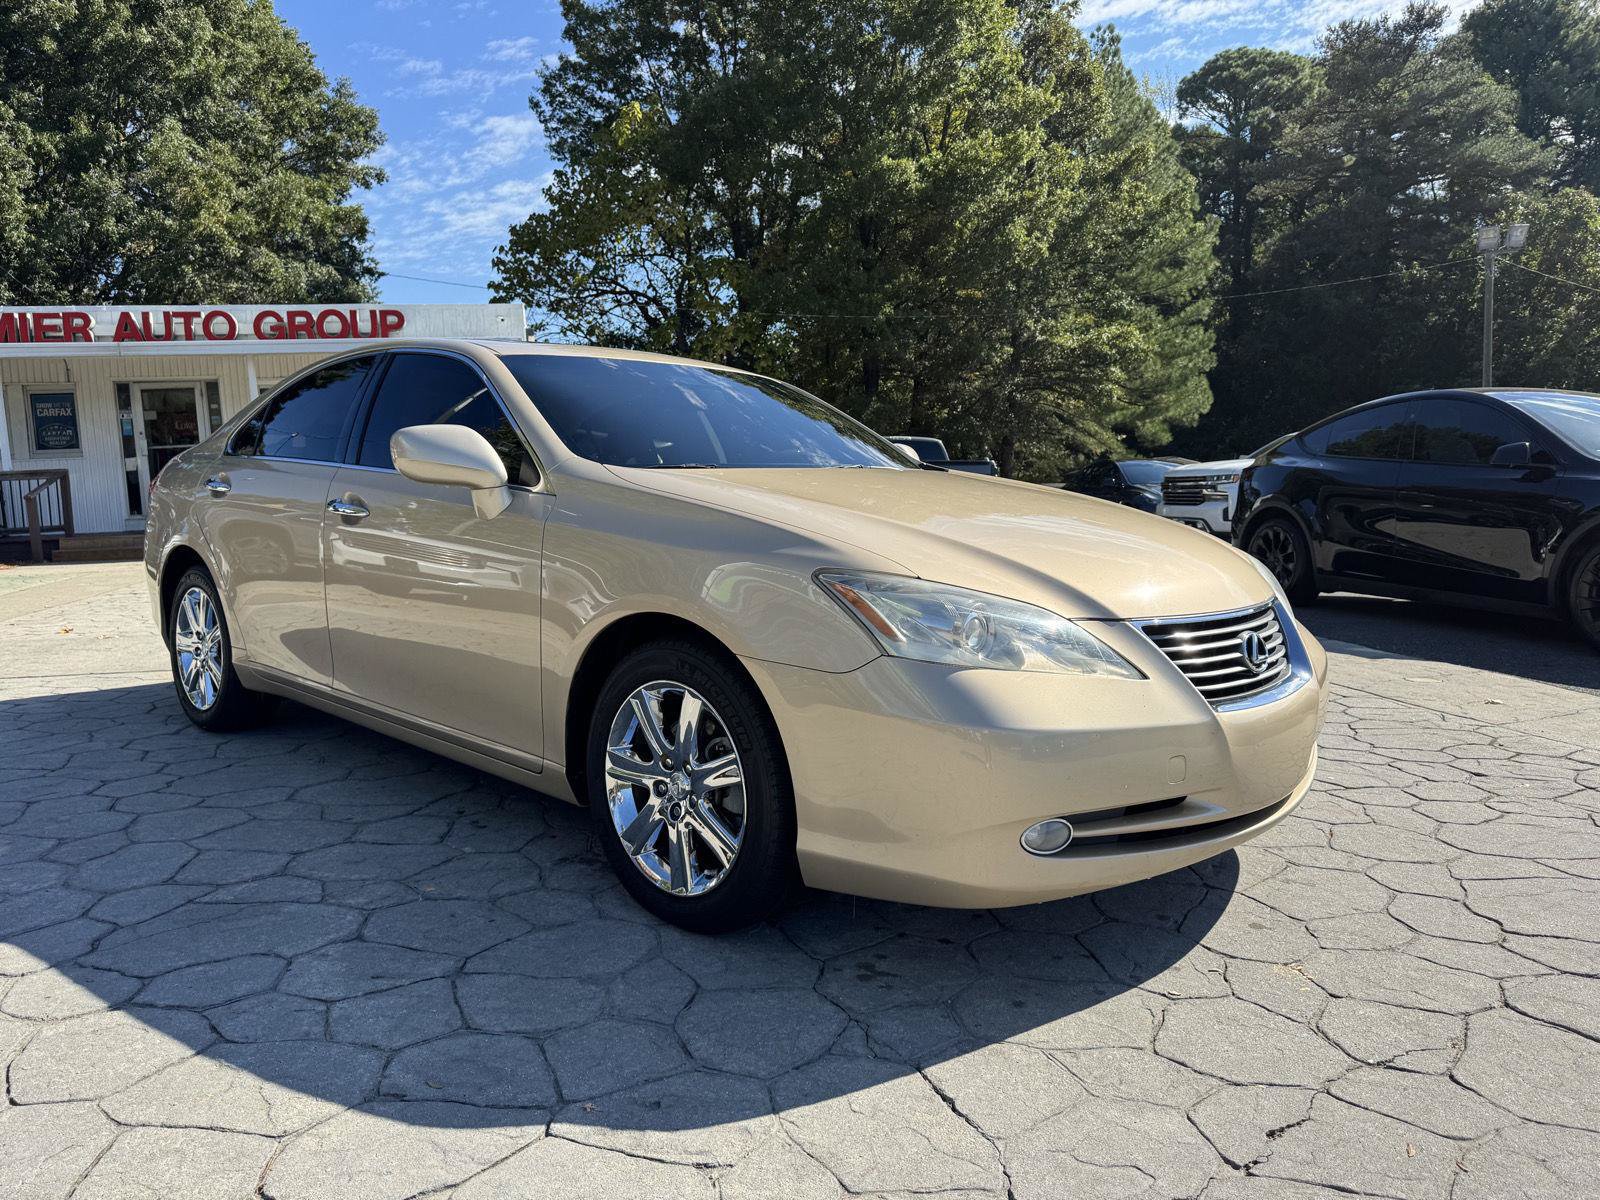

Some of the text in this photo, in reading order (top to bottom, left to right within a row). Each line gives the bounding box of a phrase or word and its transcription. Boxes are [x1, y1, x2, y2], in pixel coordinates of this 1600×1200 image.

[113, 311, 238, 342] AUTO
[253, 309, 405, 340] GROUP
[36, 408, 73, 417] CARFAX
